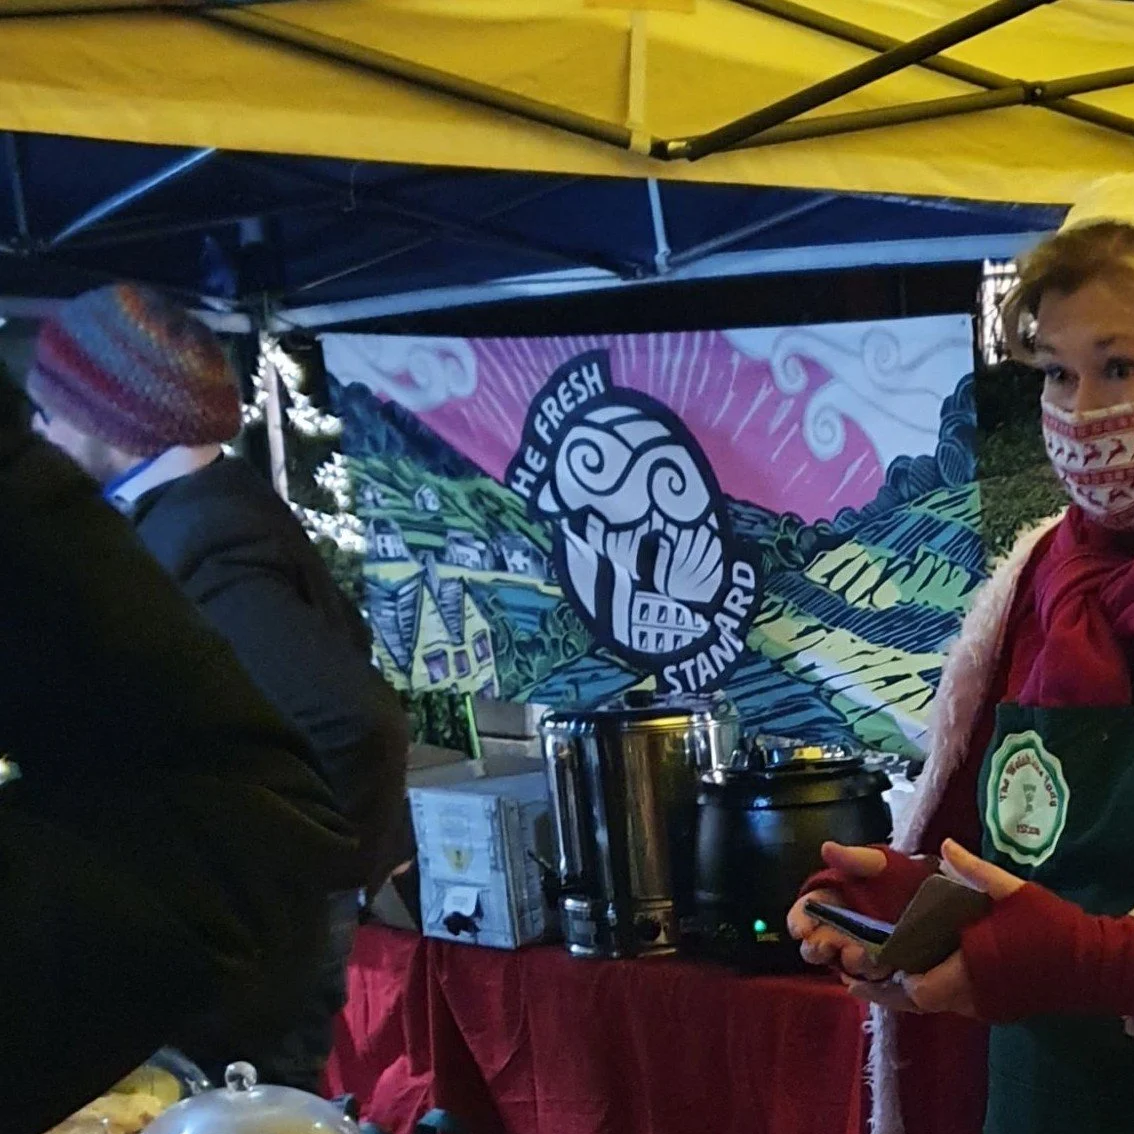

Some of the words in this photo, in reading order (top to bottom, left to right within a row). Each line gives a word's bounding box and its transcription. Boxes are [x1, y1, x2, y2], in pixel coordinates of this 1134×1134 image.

[510, 445, 547, 499] HE
[534, 362, 606, 445] FRESH
[663, 560, 756, 696] STANARD
